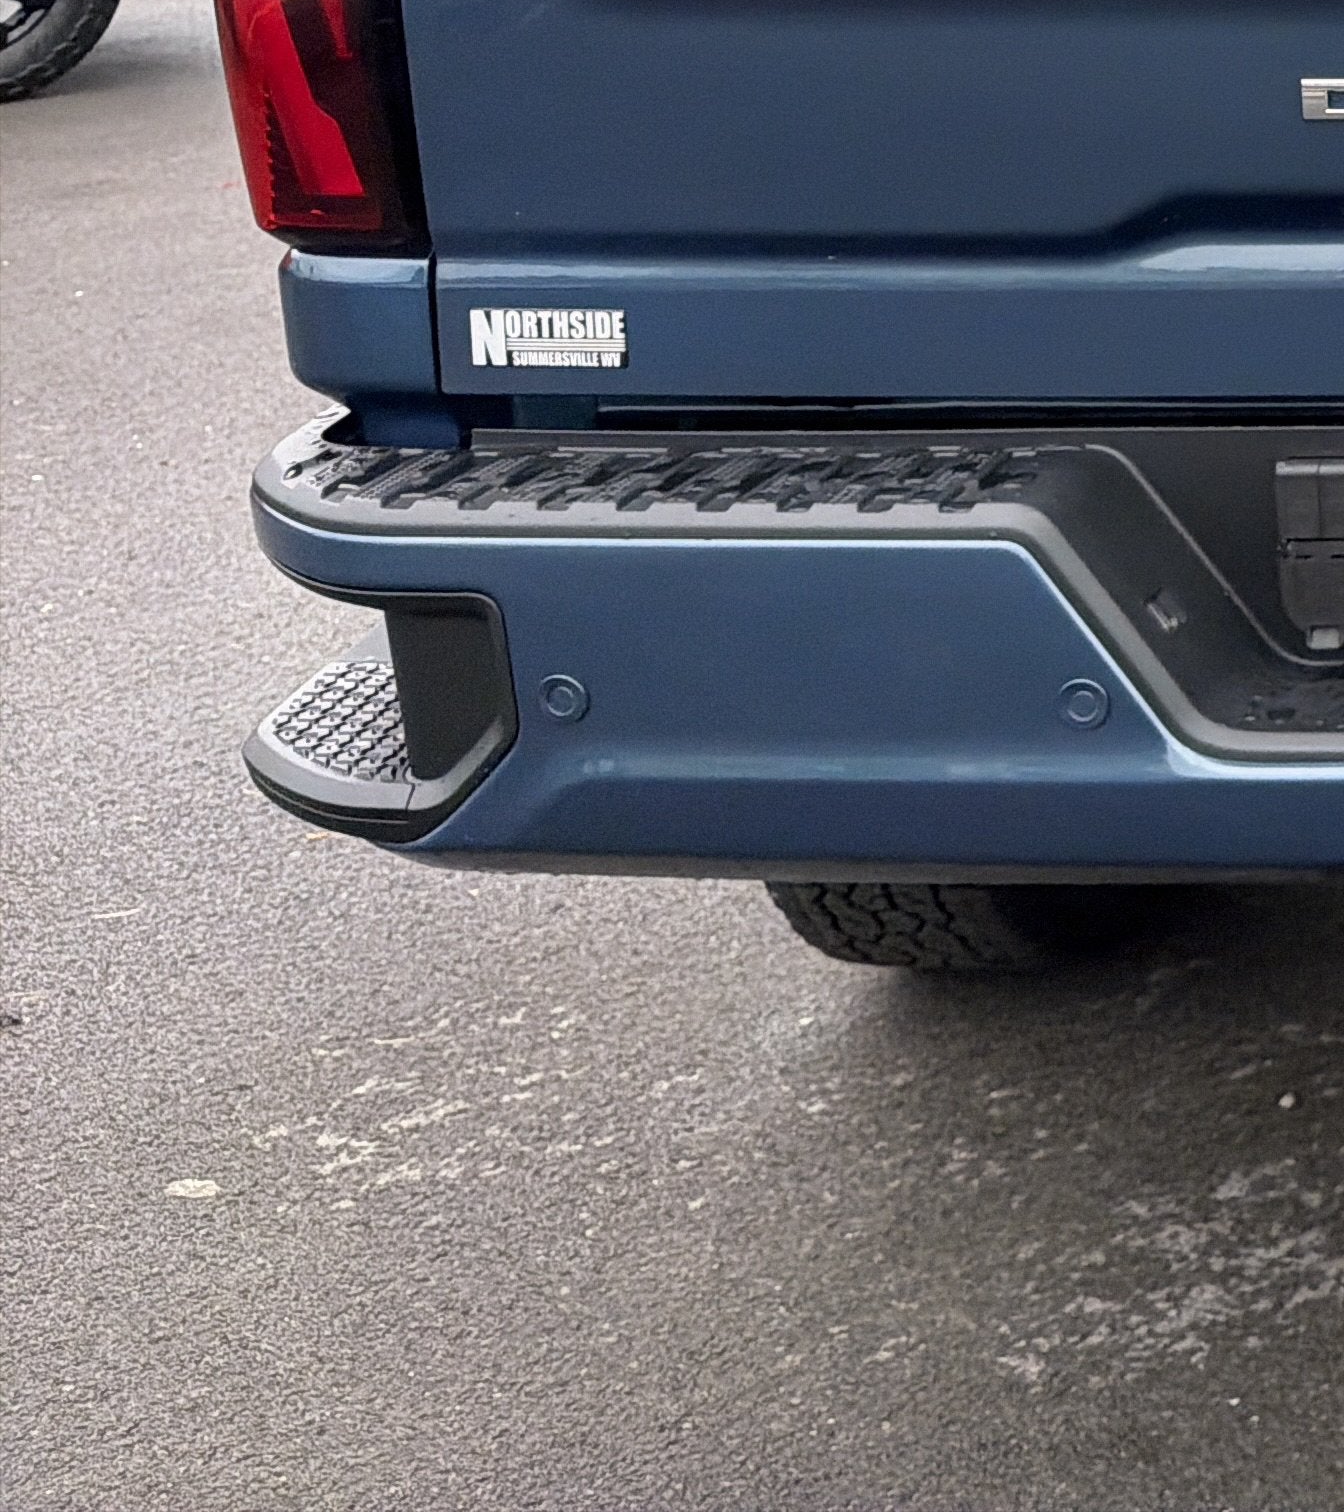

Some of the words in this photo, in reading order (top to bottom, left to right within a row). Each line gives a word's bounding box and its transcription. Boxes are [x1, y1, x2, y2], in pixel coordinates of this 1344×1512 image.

[470, 309, 626, 366] NORTHSIDE
[512, 351, 600, 367] SUMMERSVILLE
[600, 352, 622, 368] WV
